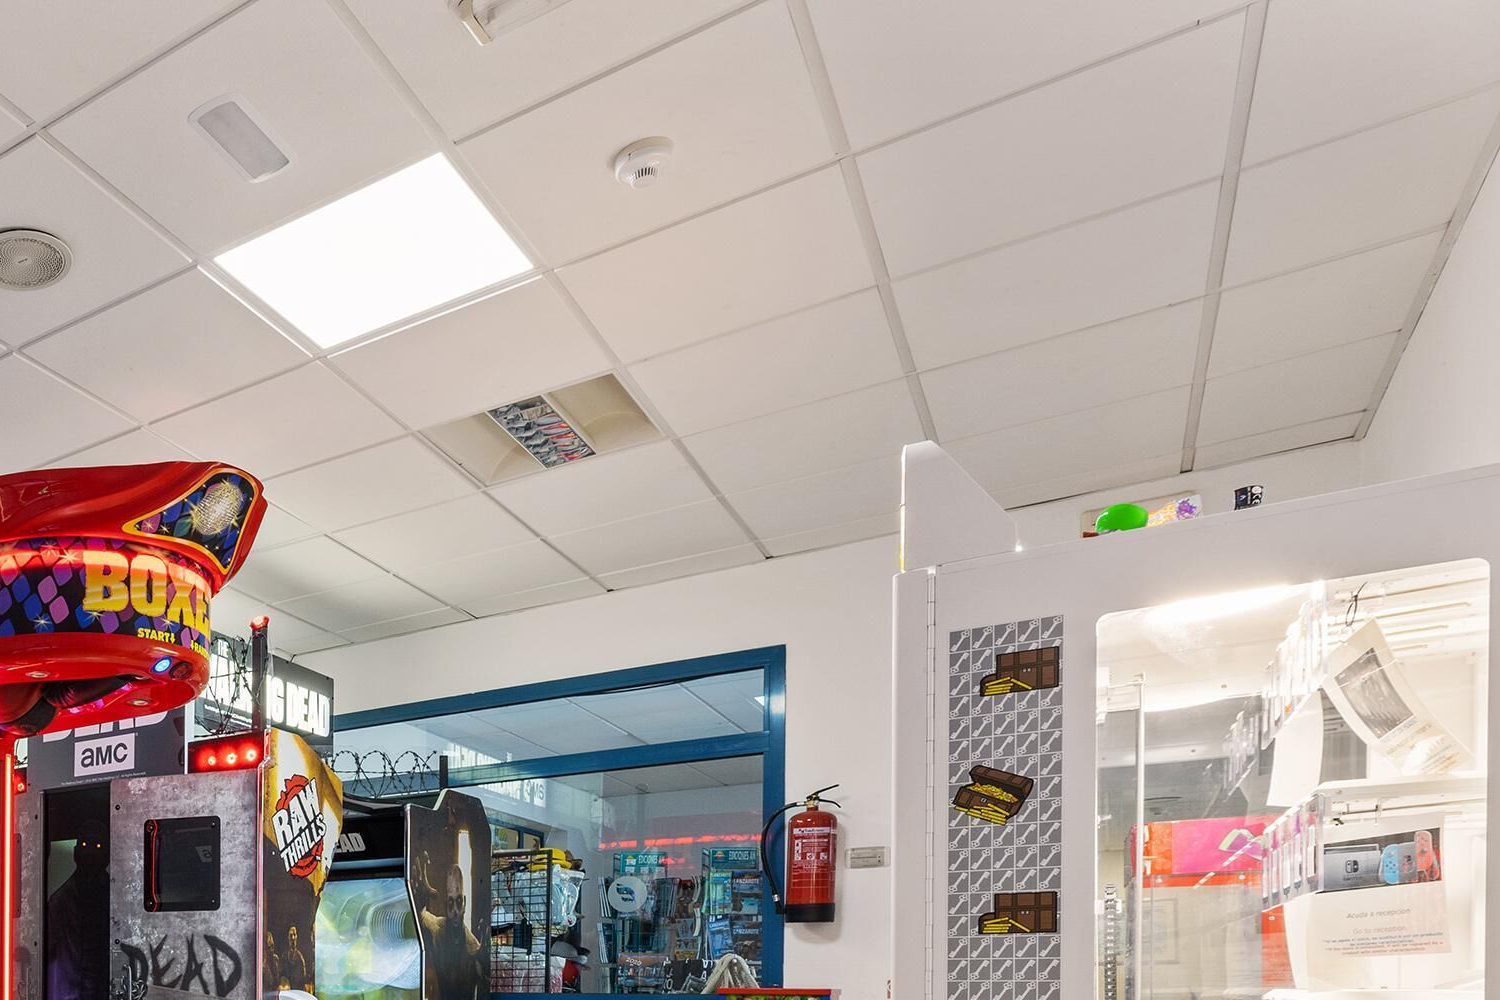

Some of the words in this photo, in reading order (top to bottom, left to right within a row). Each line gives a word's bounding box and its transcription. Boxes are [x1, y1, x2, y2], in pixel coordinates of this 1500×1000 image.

[83, 550, 211, 641] BOXE
[137, 628, 171, 642] START
[286, 682, 331, 737] DEAD
[272, 778, 320, 852] RAW
[280, 813, 327, 872] THRILLS
[120, 933, 242, 997] DEAD
